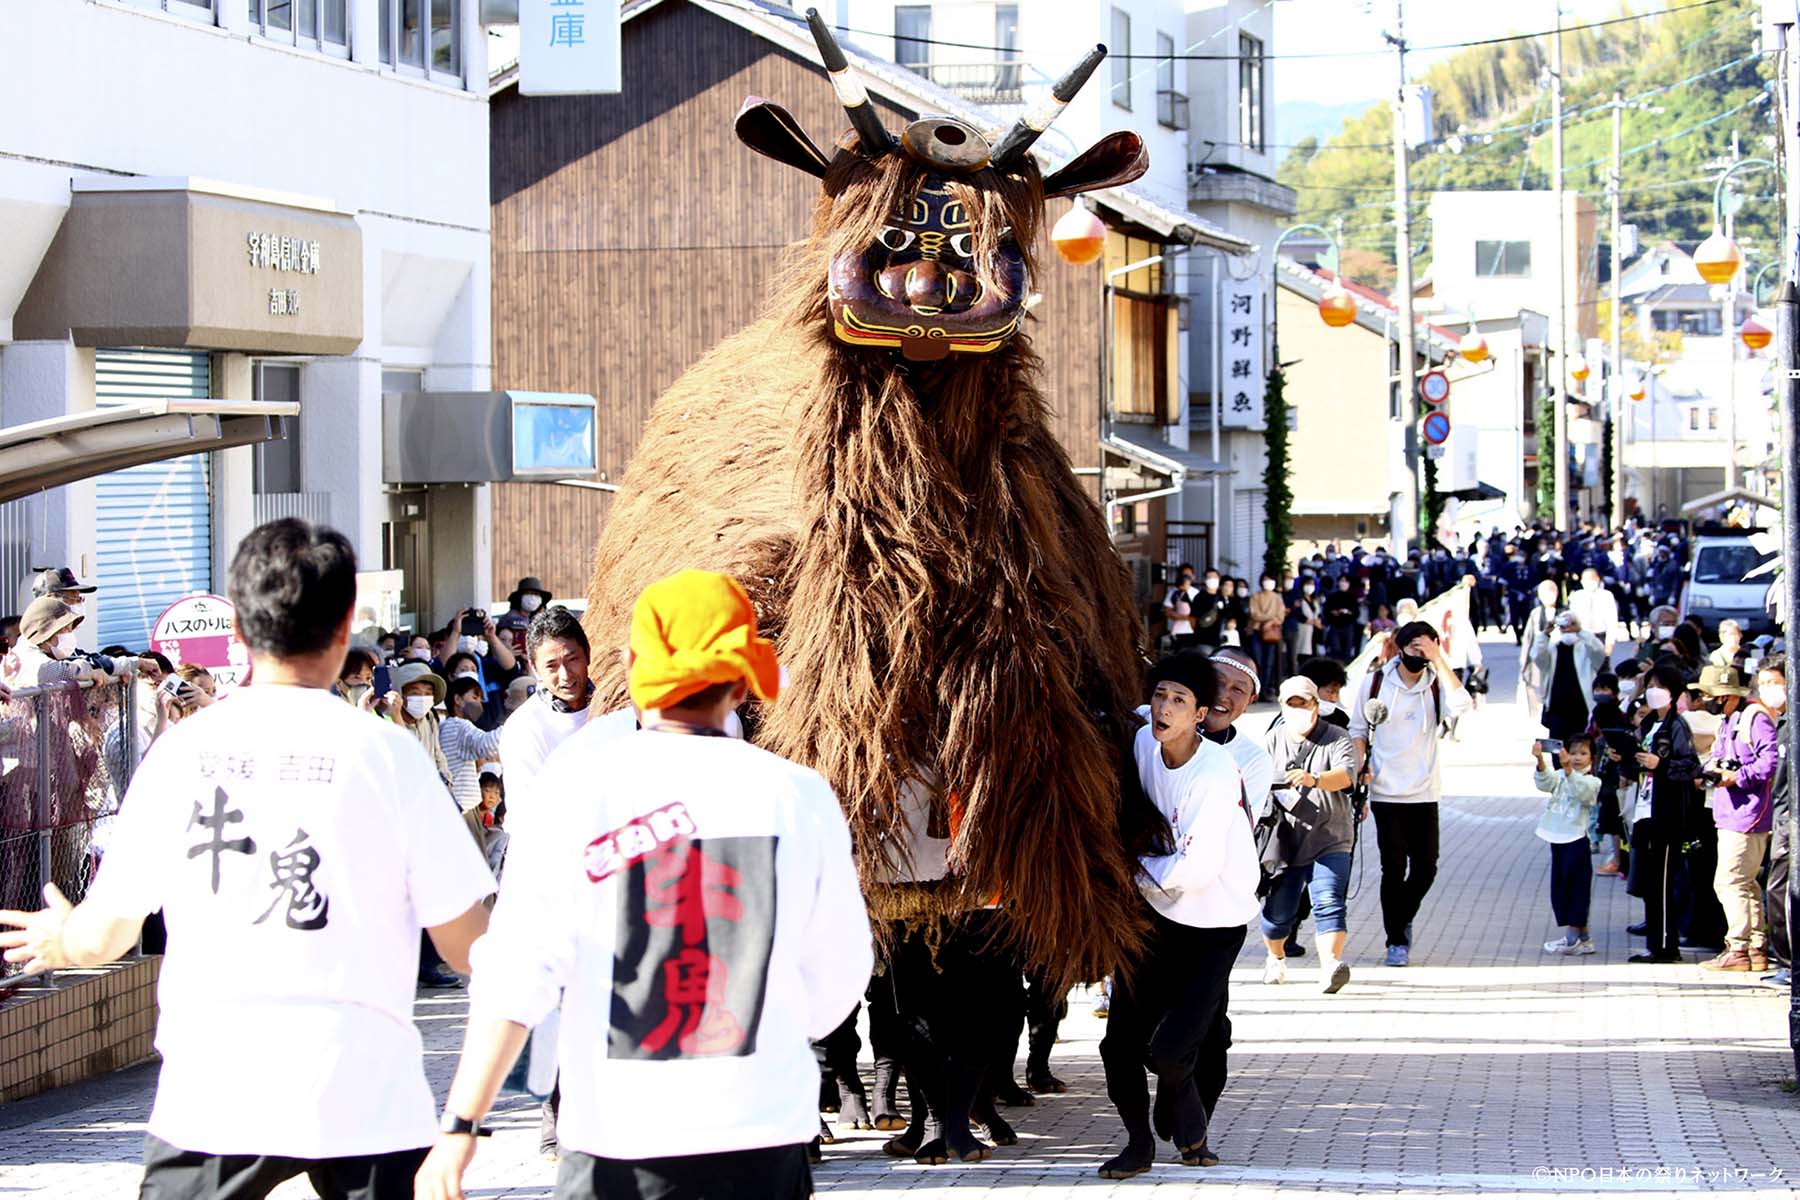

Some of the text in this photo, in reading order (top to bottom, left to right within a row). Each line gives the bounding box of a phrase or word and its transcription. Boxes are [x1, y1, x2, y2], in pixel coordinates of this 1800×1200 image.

[247, 231, 321, 275] 宇和島信用金庫
[1231, 293, 1253, 413] 河野鮮魚
[1428, 379, 1445, 396] 30
